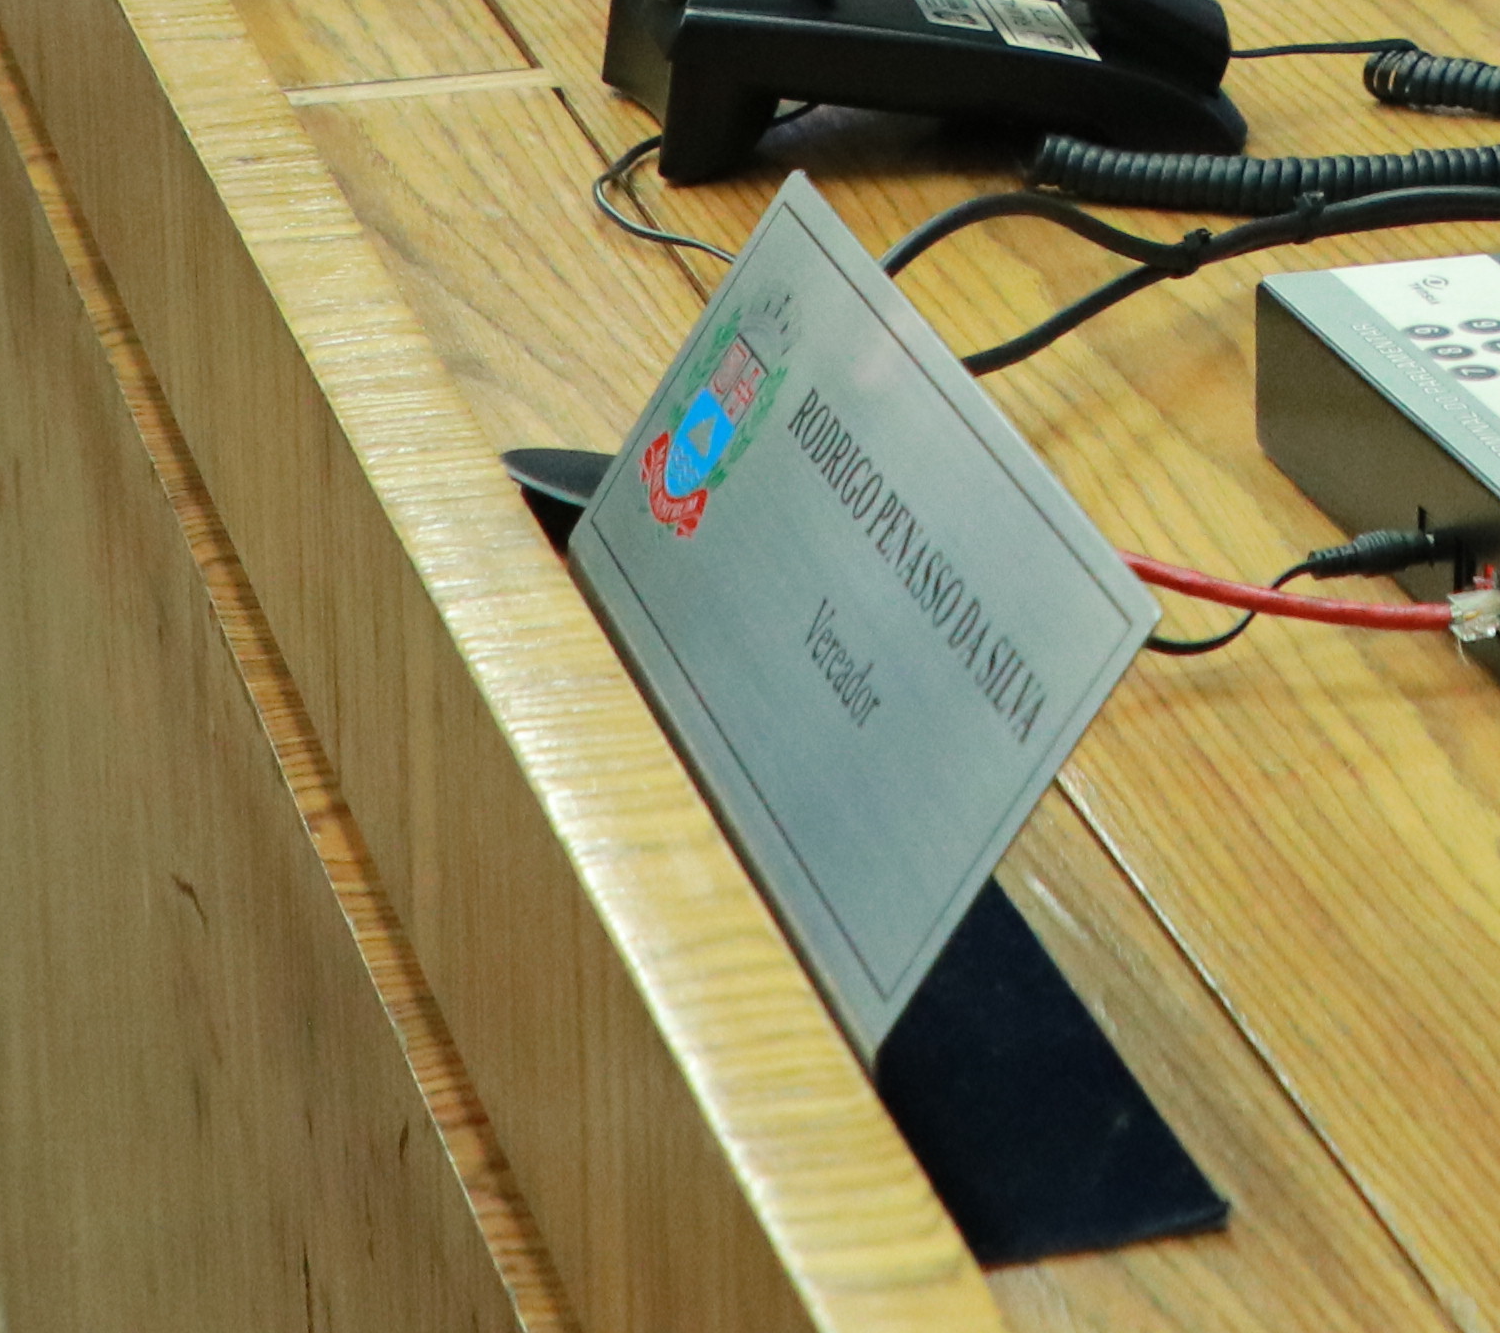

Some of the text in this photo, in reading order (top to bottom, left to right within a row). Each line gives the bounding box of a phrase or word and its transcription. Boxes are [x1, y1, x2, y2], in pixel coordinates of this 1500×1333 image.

[1414, 326, 1441, 335] 9
[1471, 320, 1498, 329] 6
[1437, 347, 1463, 356] 8
[1352, 321, 1442, 402] PARLAMENTAR
[1461, 367, 1488, 377] 7
[1437, 390, 1469, 414] DO
[787, 386, 1047, 746] RODRIGO PENASSO DA SILVA
[803, 595, 882, 729] Vereador
